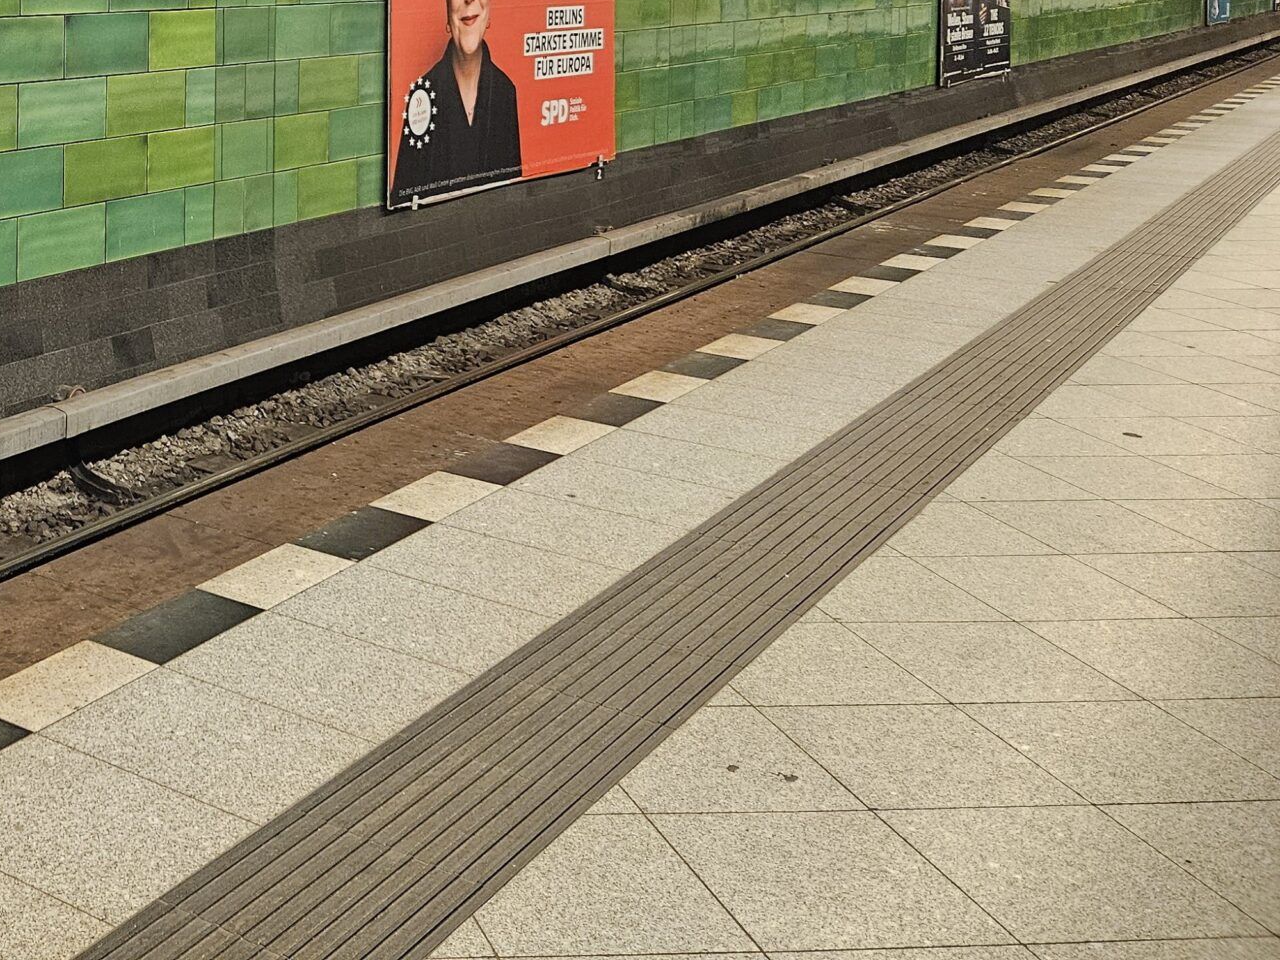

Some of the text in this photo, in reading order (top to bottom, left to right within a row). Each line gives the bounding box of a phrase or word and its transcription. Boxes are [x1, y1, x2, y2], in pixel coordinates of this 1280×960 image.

[548, 8, 583, 26] BERLINS
[525, 31, 602, 54] STÄRKSTE STIMME
[536, 55, 592, 77] FÜR EUROPA
[541, 98, 569, 126] SPD
